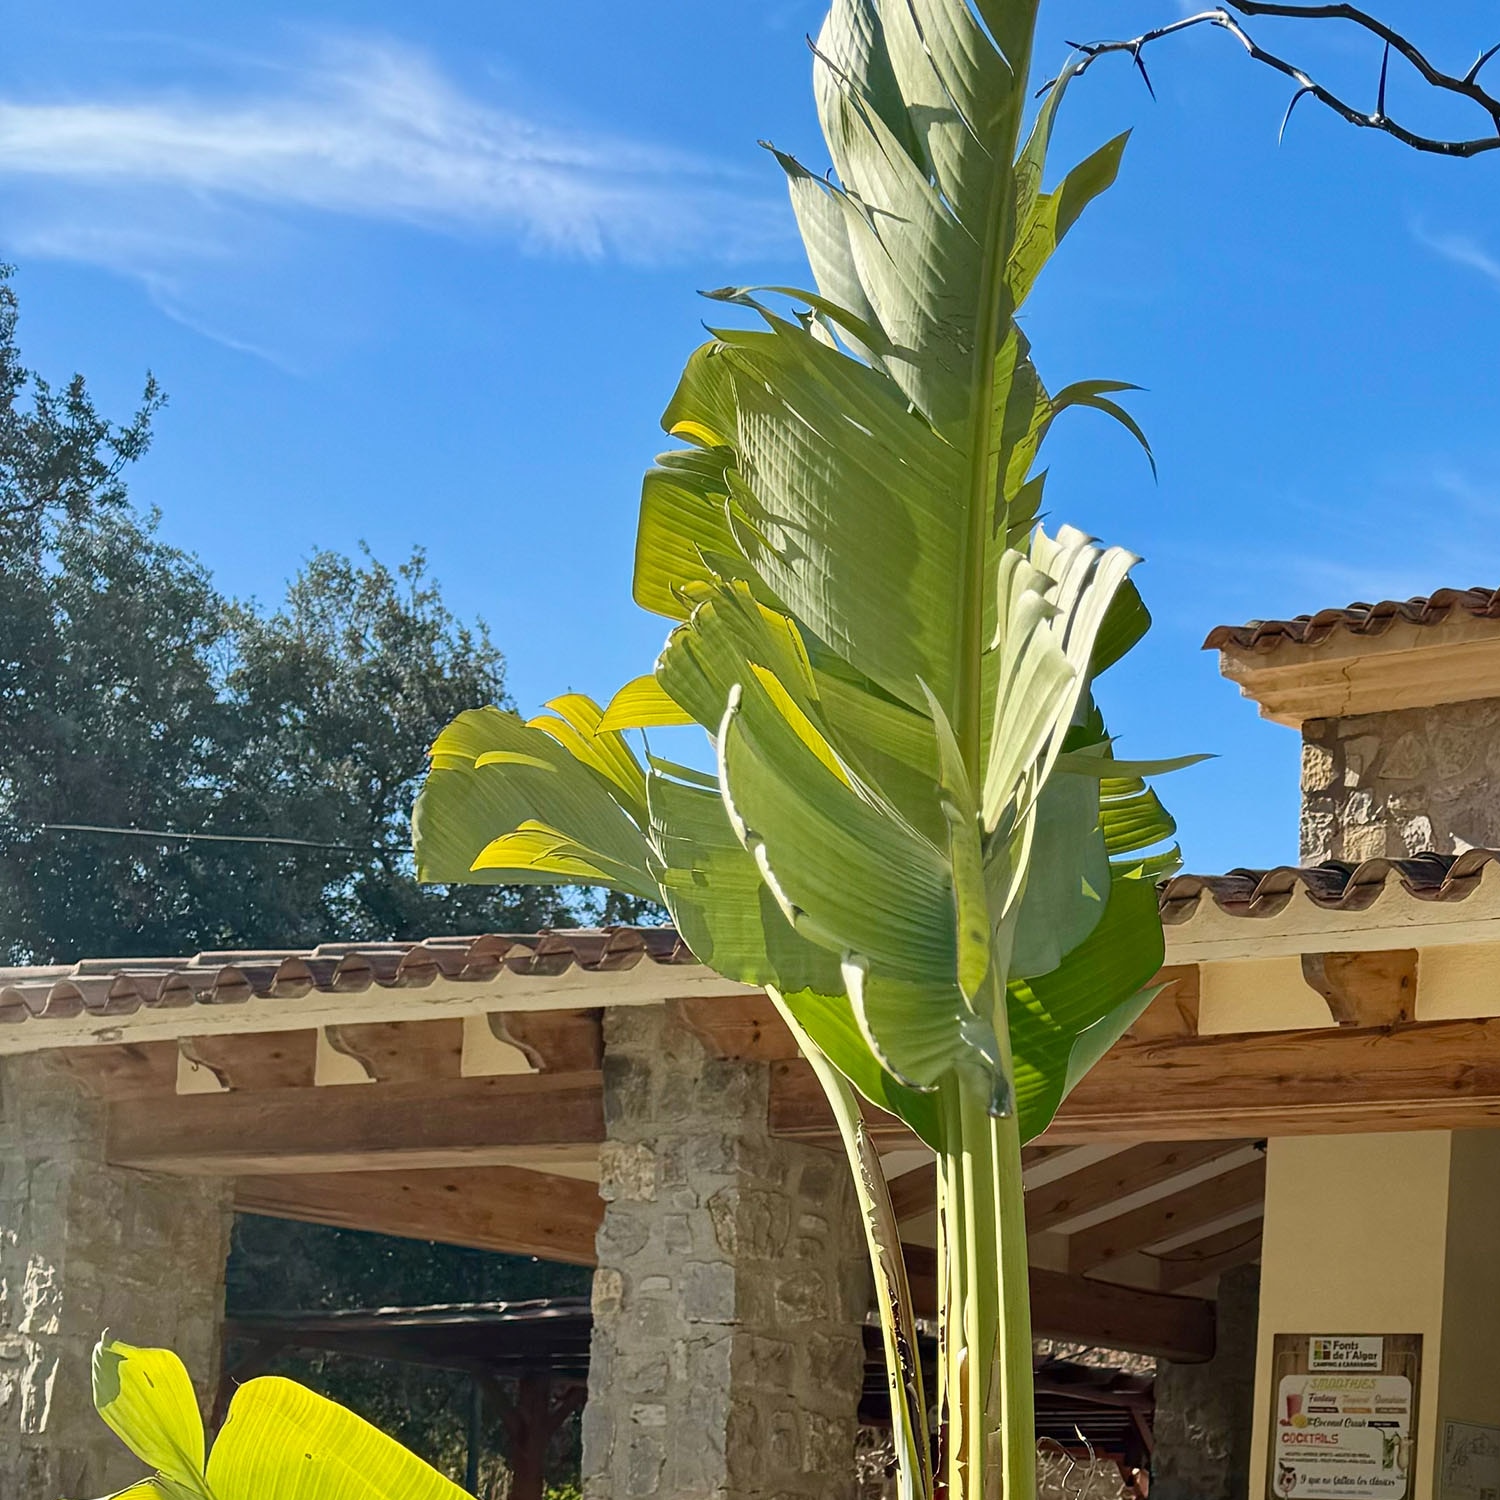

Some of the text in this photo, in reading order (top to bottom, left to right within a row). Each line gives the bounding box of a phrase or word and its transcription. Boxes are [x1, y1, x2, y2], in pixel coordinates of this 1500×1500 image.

[1333, 1340, 1359, 1350] Fonts
[1333, 1351, 1344, 1360] de
[1310, 1378, 1377, 1390] SMOOTHIES
[1282, 1433, 1338, 1444] COCKTAILS
